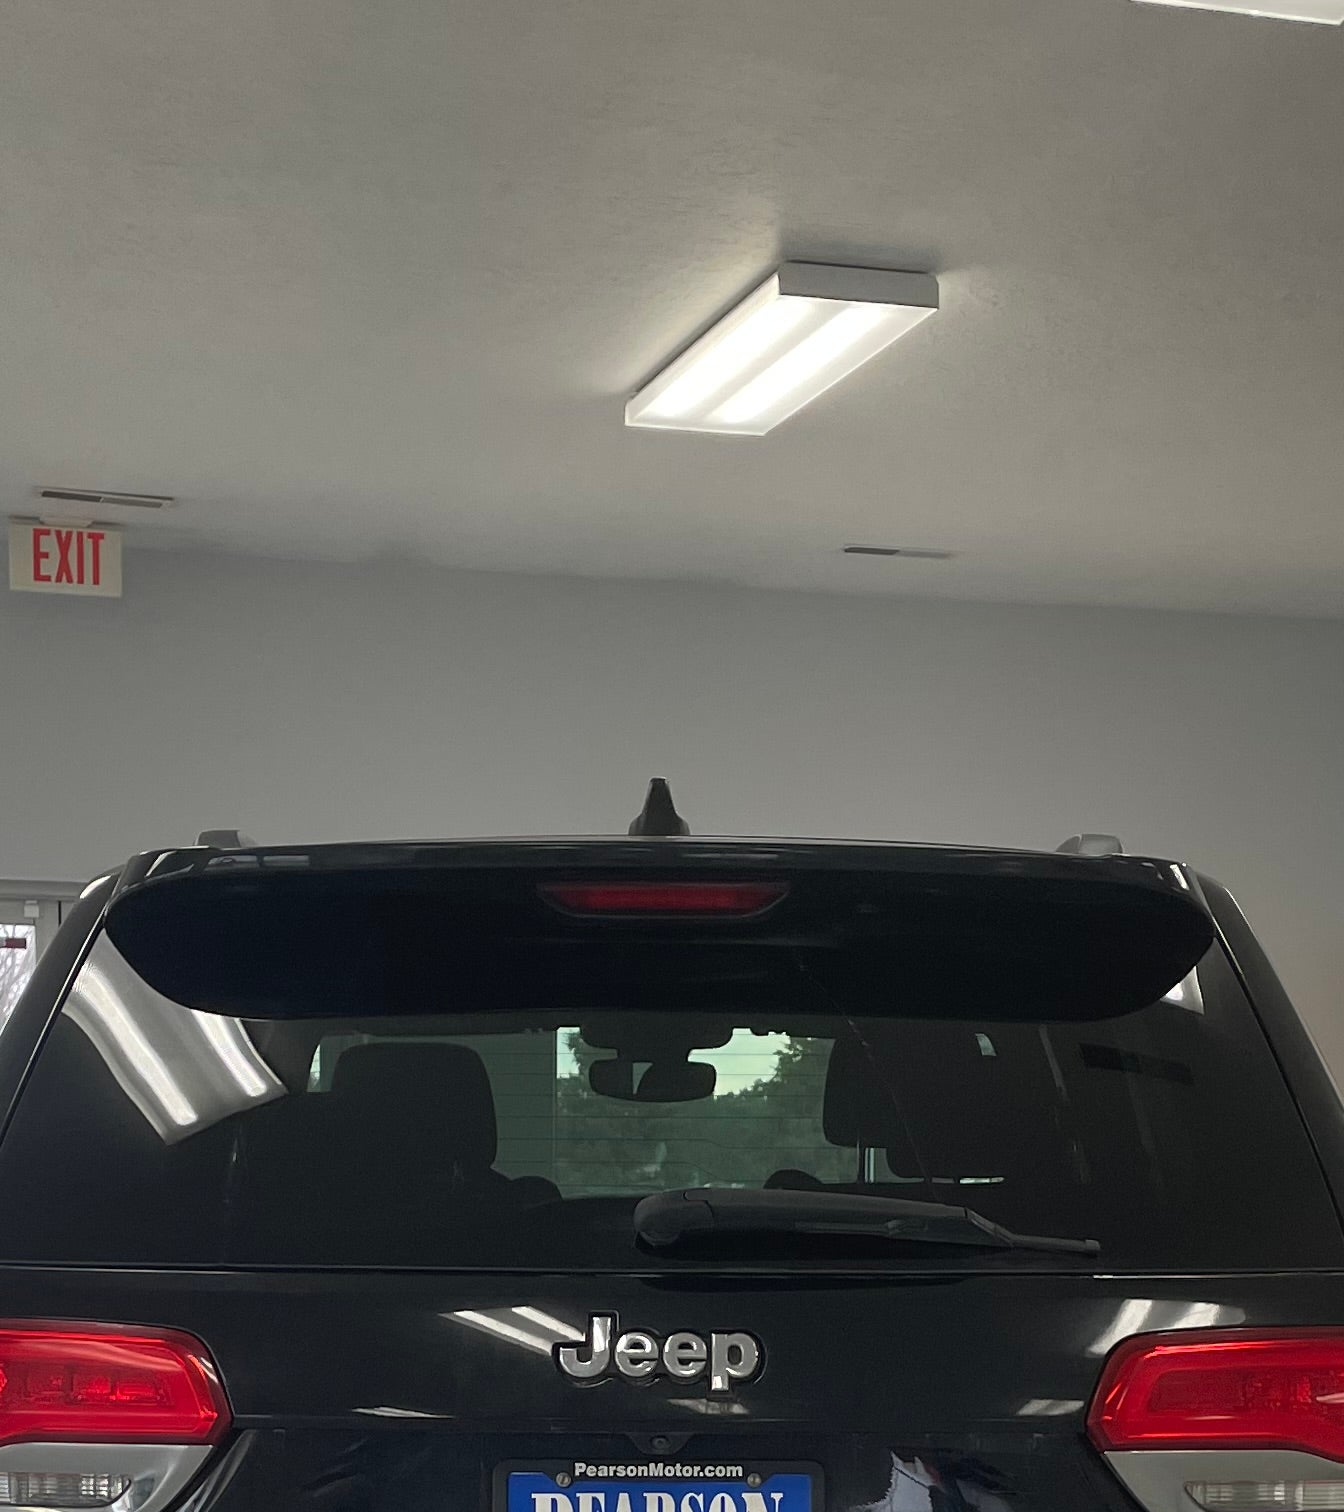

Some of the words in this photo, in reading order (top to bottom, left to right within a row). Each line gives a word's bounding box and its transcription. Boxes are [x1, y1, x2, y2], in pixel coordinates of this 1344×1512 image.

[33, 528, 105, 585] EXIT
[559, 1316, 758, 1391] Jeep
[574, 1462, 743, 1478] PearsonMotor.com
